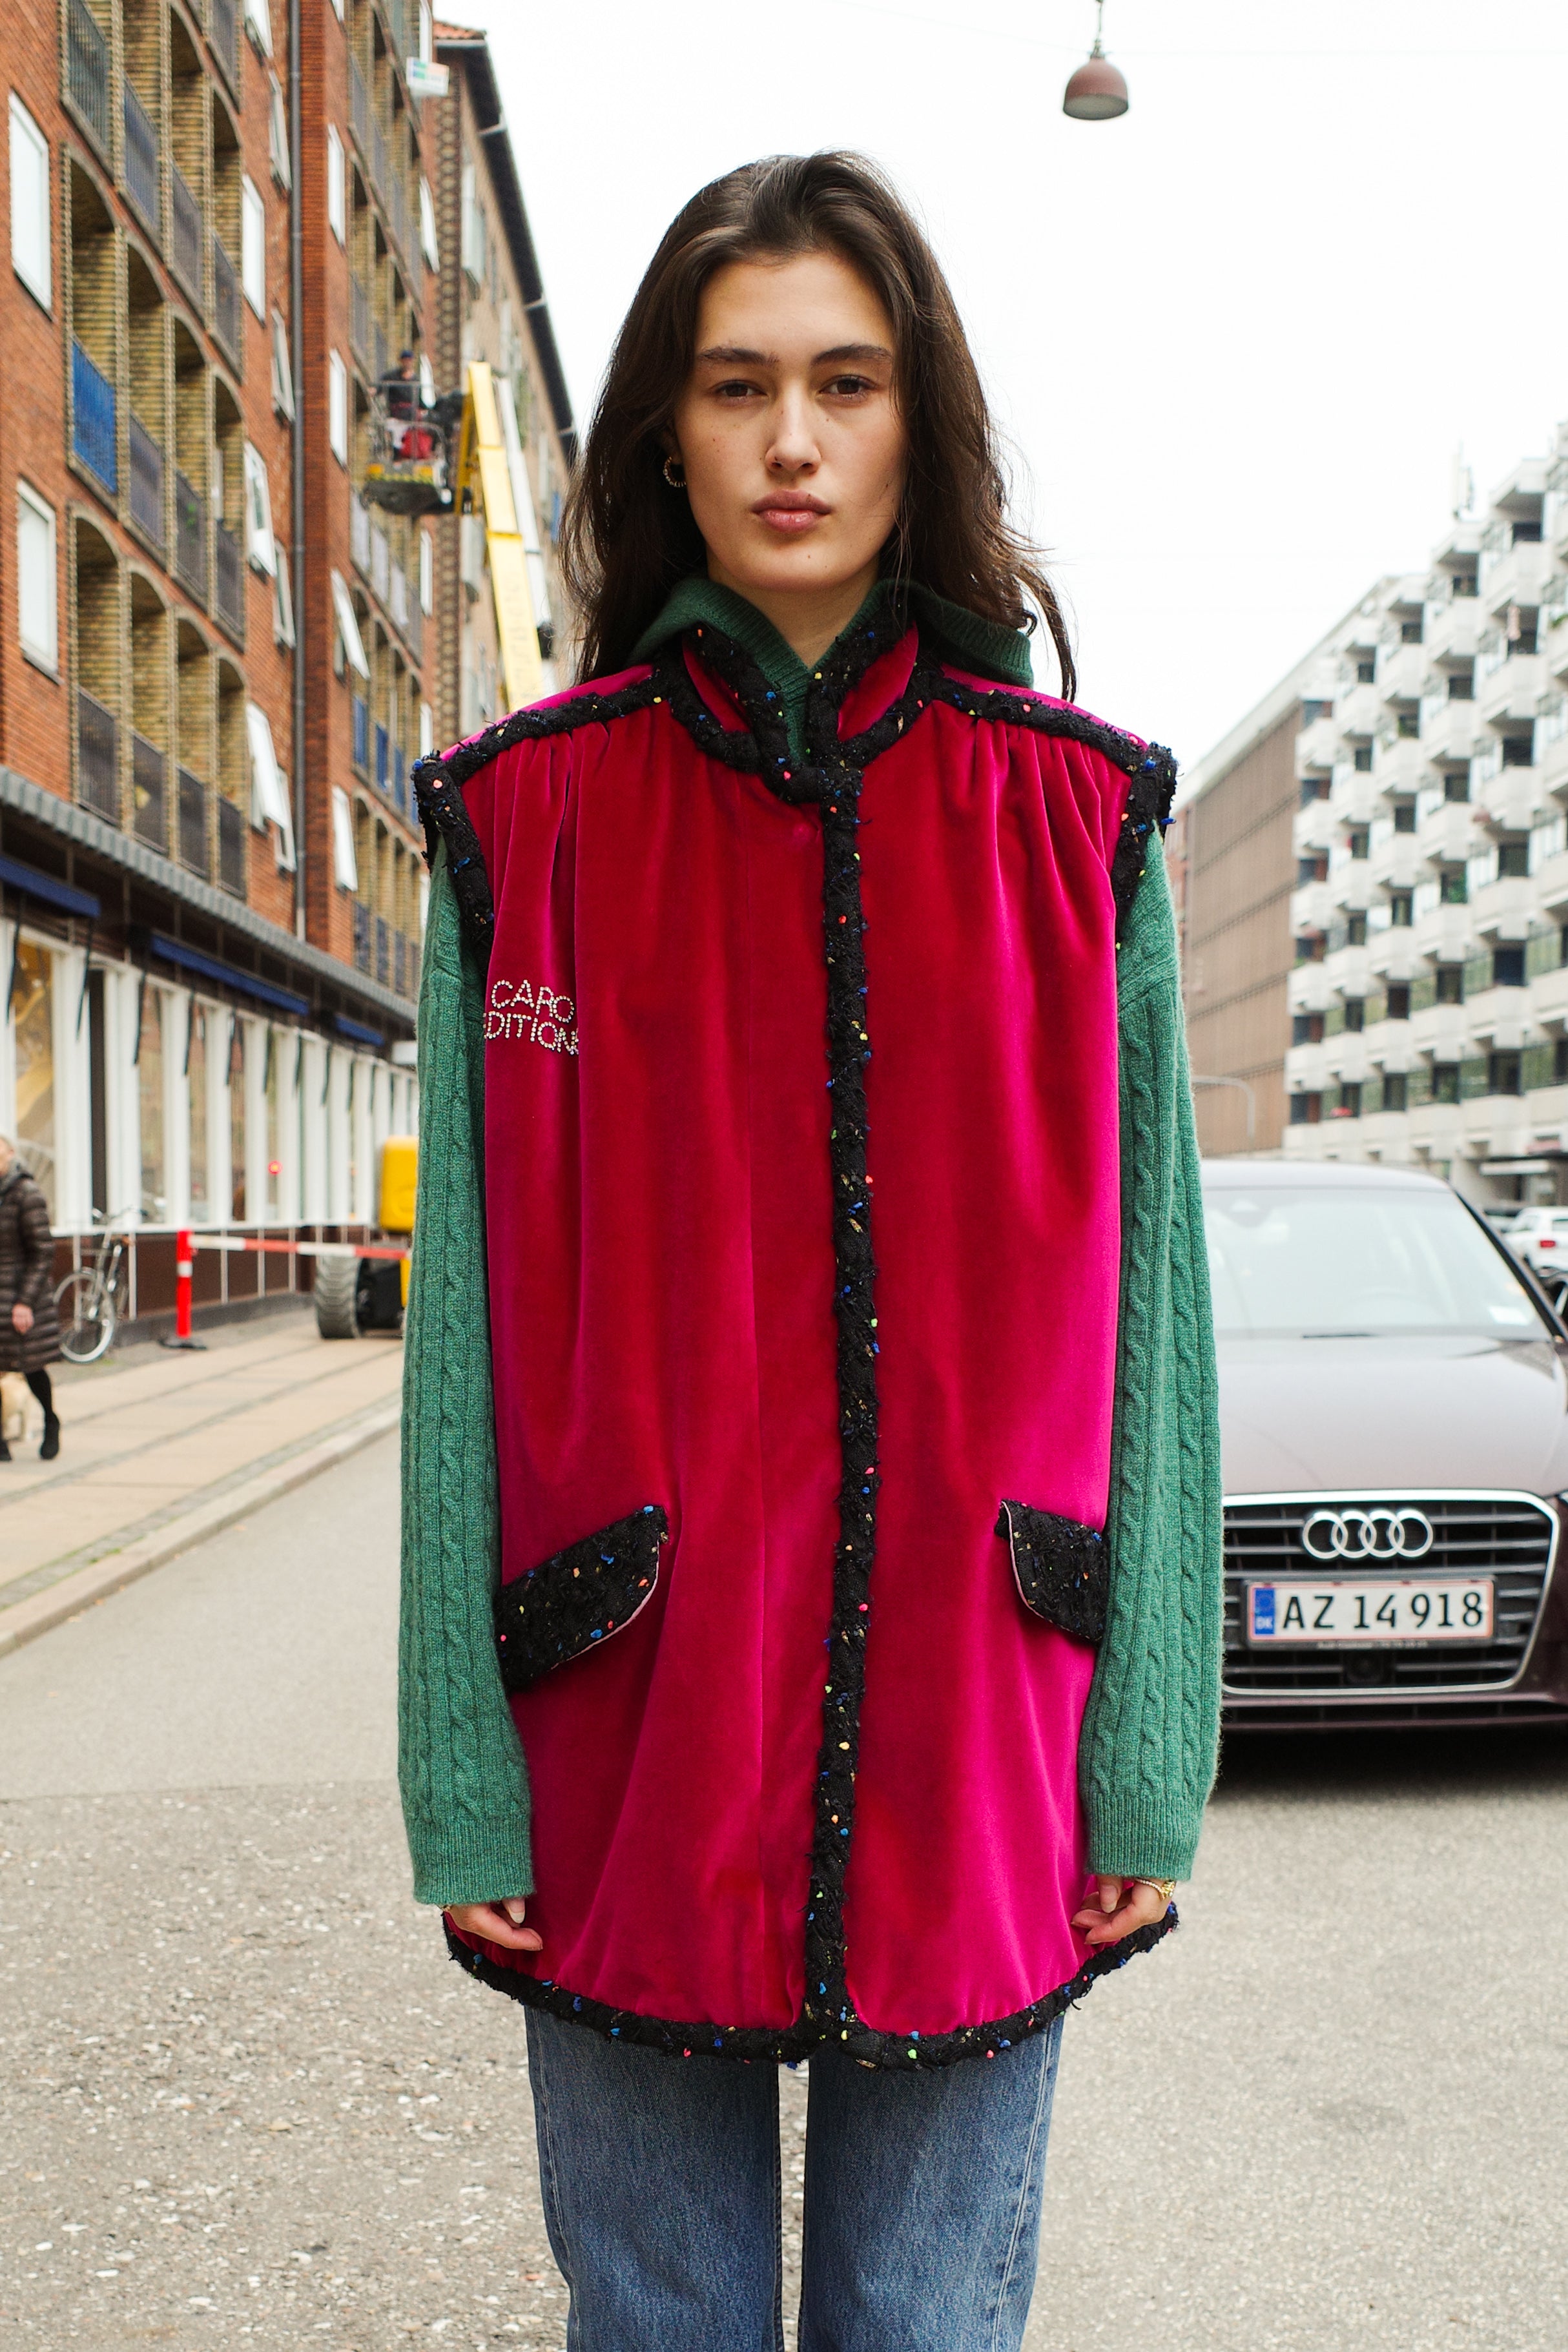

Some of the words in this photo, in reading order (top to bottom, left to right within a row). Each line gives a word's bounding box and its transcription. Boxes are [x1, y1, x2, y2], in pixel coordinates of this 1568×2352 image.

[491, 979, 575, 1023] CARO
[483, 1011, 579, 1055] DITION
[1255, 1616, 1273, 1630] DK
[1283, 1596, 1334, 1629] AZ
[1354, 1595, 1396, 1629] 14
[1410, 1592, 1483, 1628] 918
